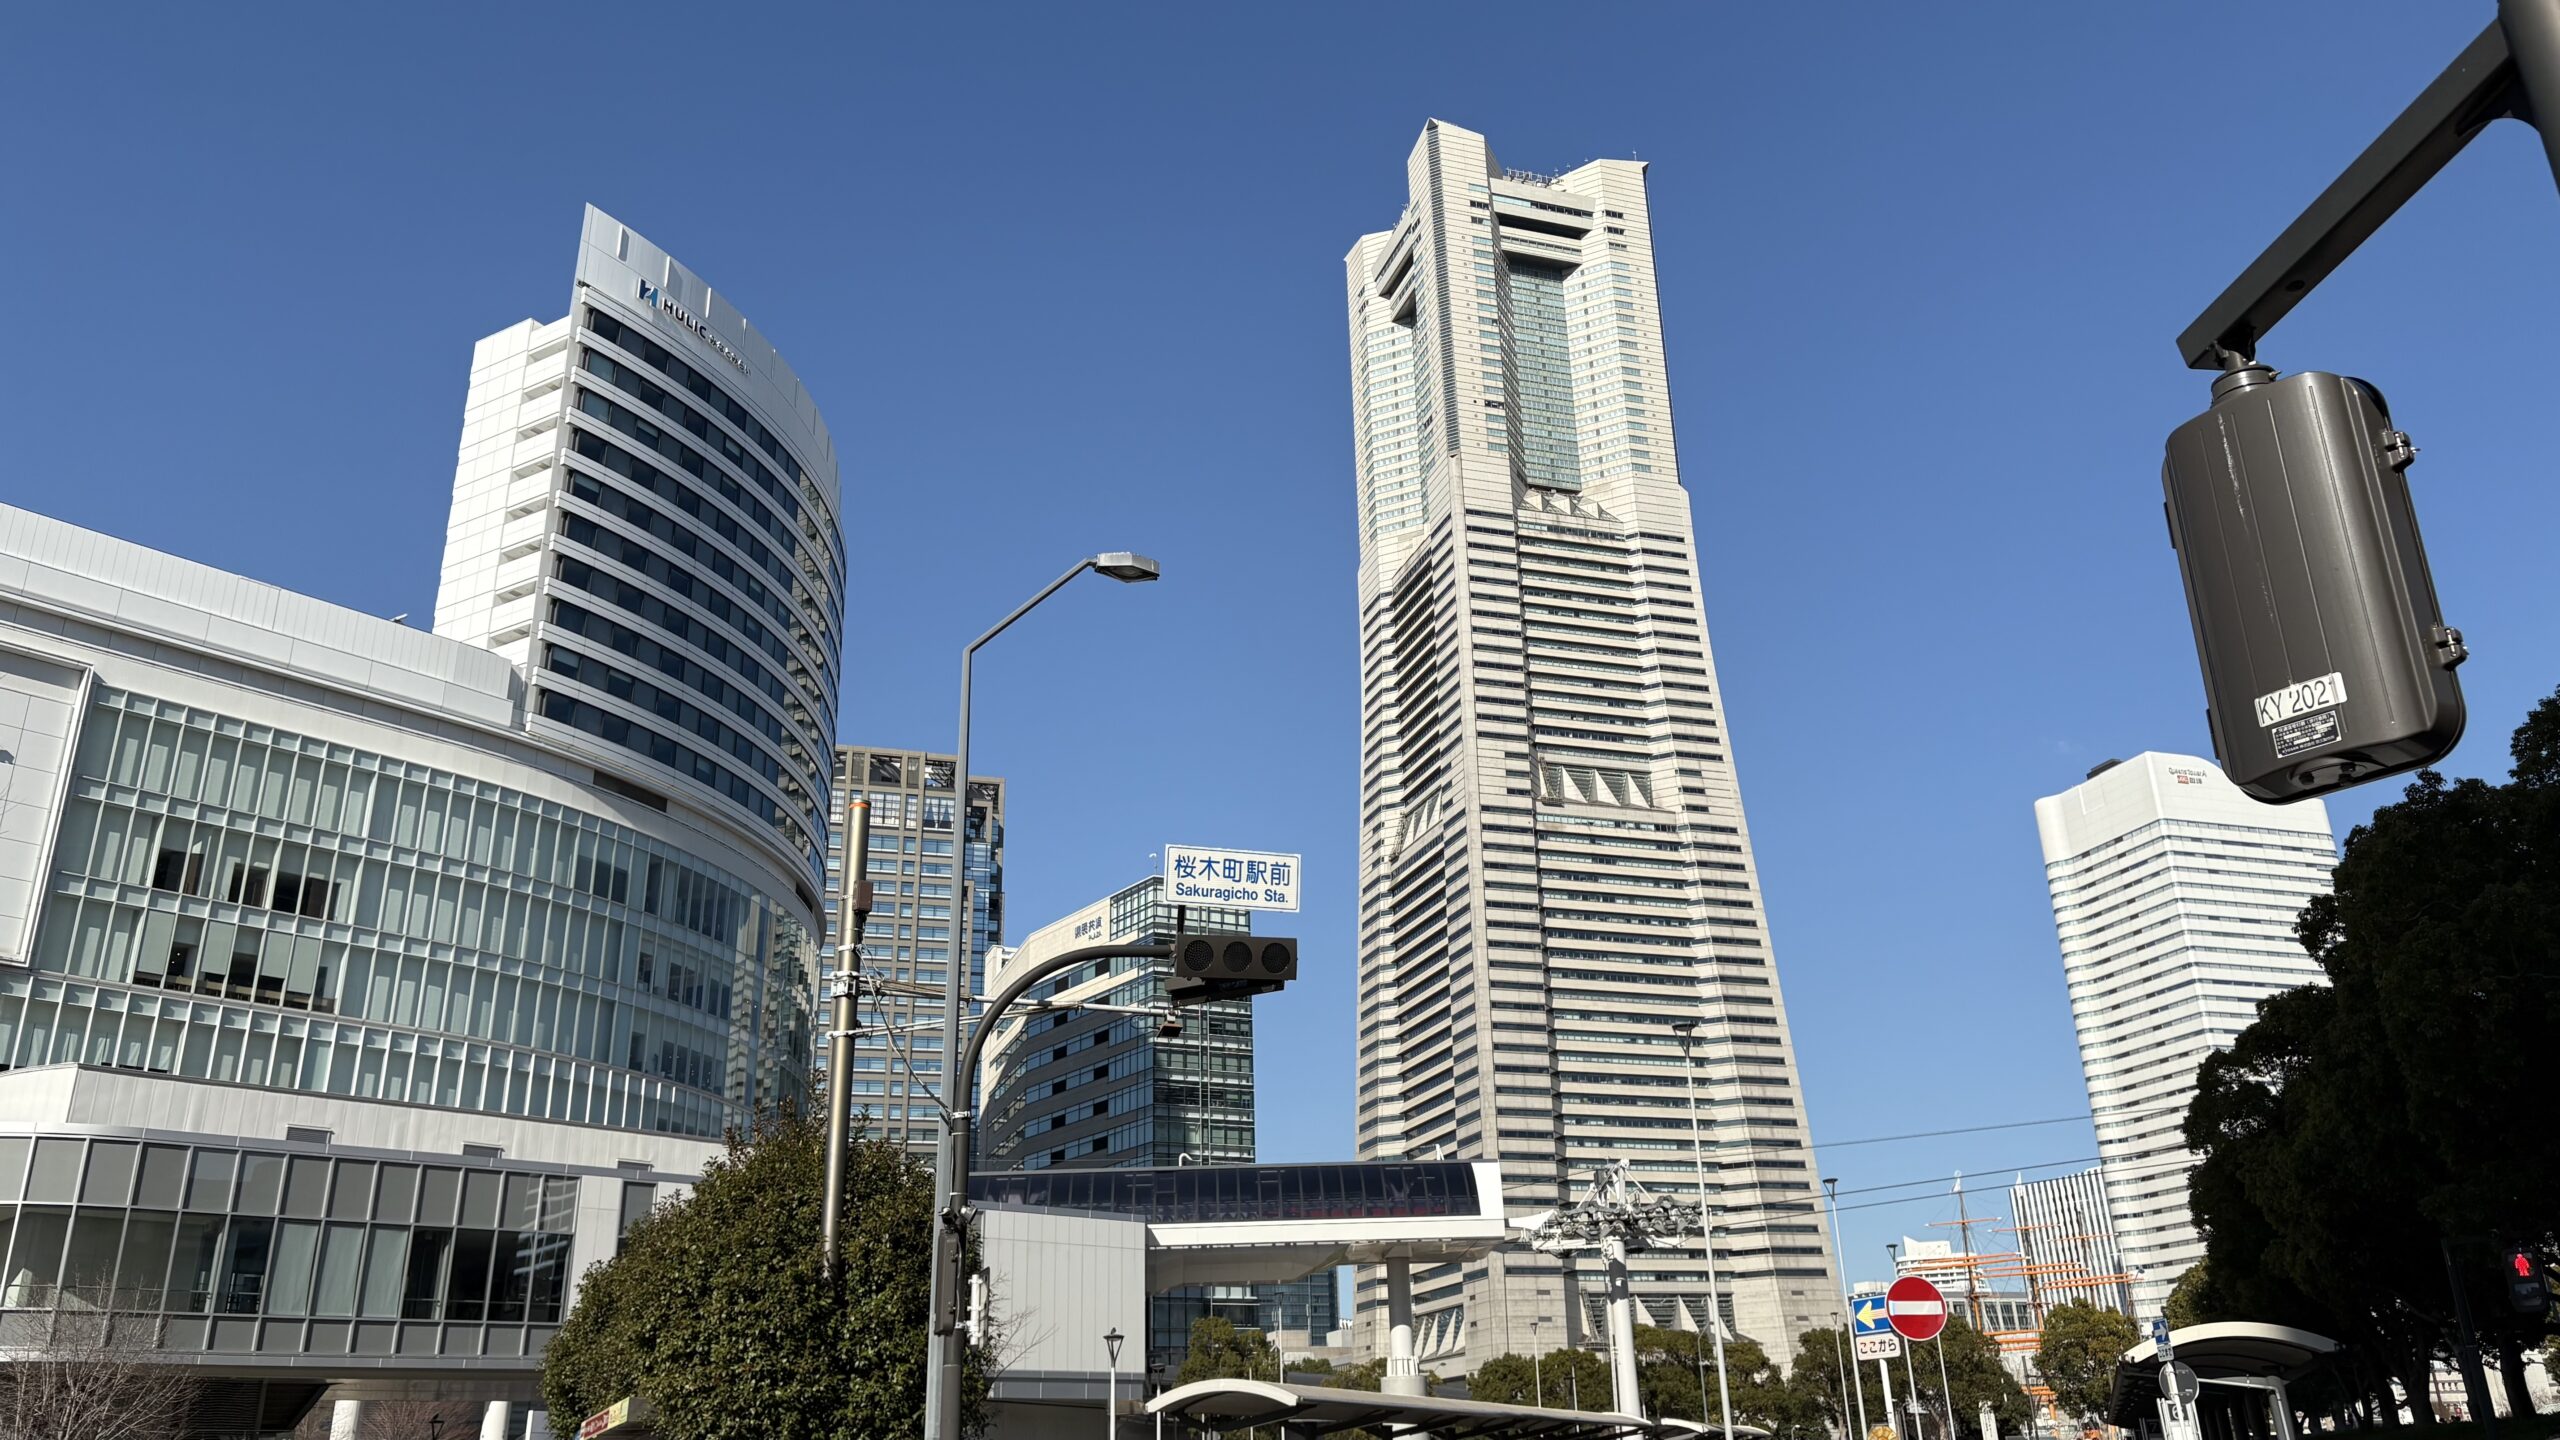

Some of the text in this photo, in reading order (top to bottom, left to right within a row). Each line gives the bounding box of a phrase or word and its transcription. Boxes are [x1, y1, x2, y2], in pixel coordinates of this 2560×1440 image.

[663, 298, 707, 340] HULIC
[2258, 679, 2334, 724] KY 202
[1174, 854, 1292, 887] 桜木町駅前
[1176, 882, 1289, 903] Sakuragicho Sta.
[1859, 1338, 1897, 1355] ここから
